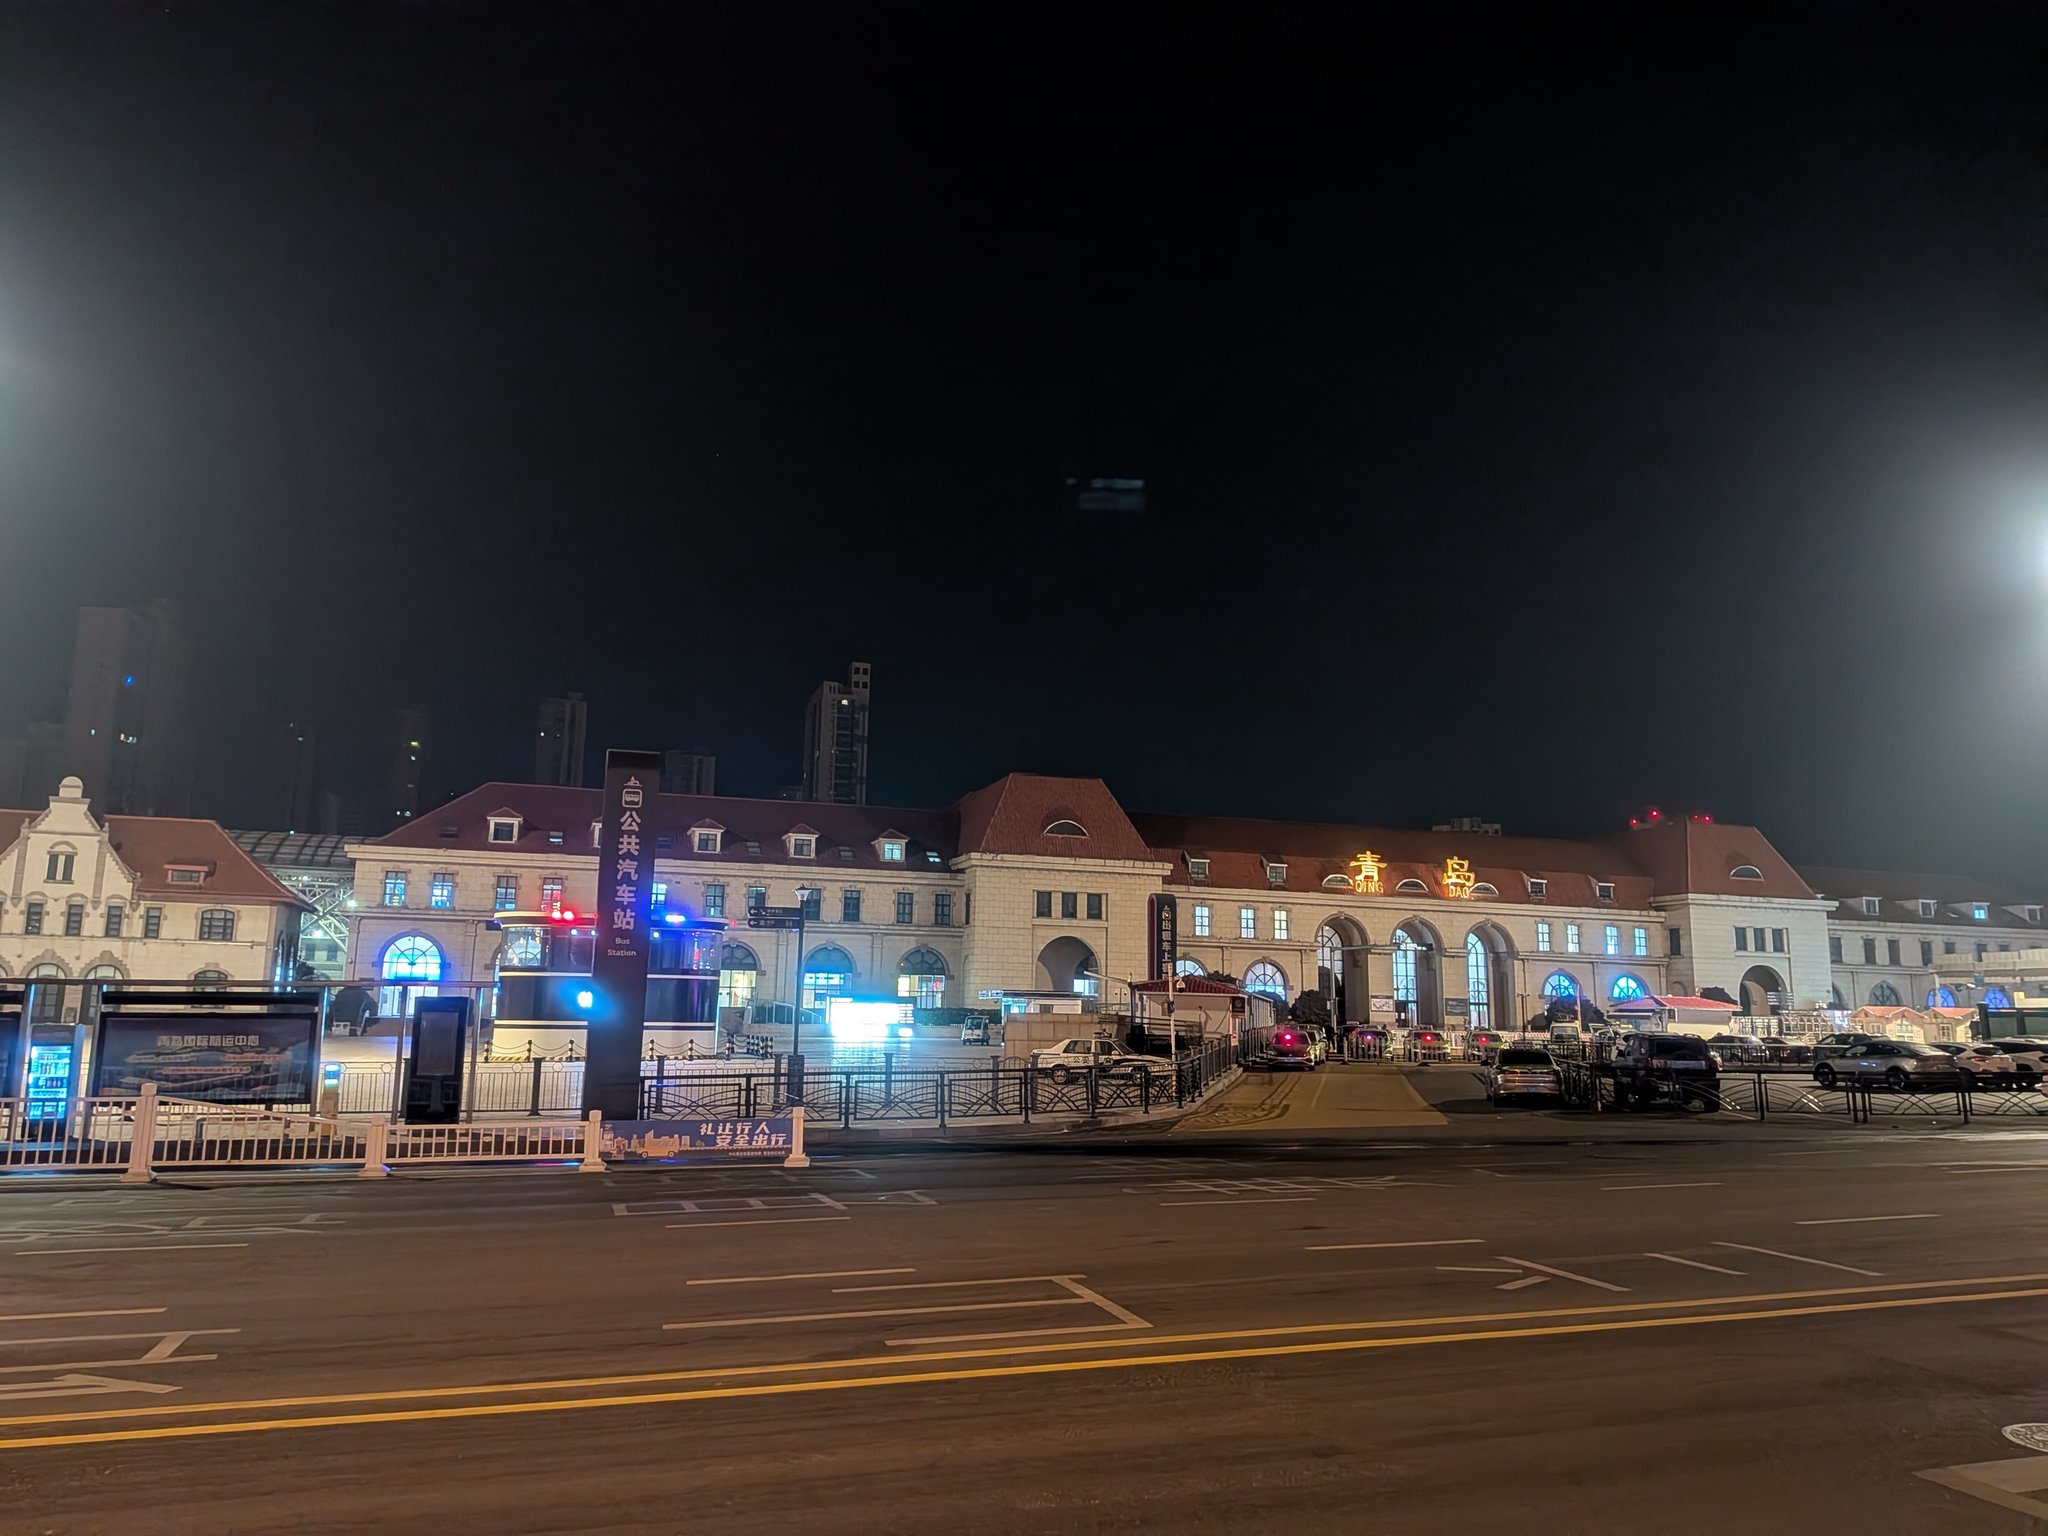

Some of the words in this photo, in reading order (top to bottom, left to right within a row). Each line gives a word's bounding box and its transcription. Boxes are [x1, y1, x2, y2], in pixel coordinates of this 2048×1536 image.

[613, 811, 642, 930] 公共汽车站
[1349, 850, 1476, 886] 青岛
[1355, 881, 1384, 894] QING
[1448, 886, 1471, 898] DAO
[615, 936, 631, 946] Bus
[607, 948, 637, 957] Station
[1073, 1055, 1090, 1065] 公安
[699, 1121, 770, 1136] 礼让行人
[715, 1133, 787, 1148] 安全出行
